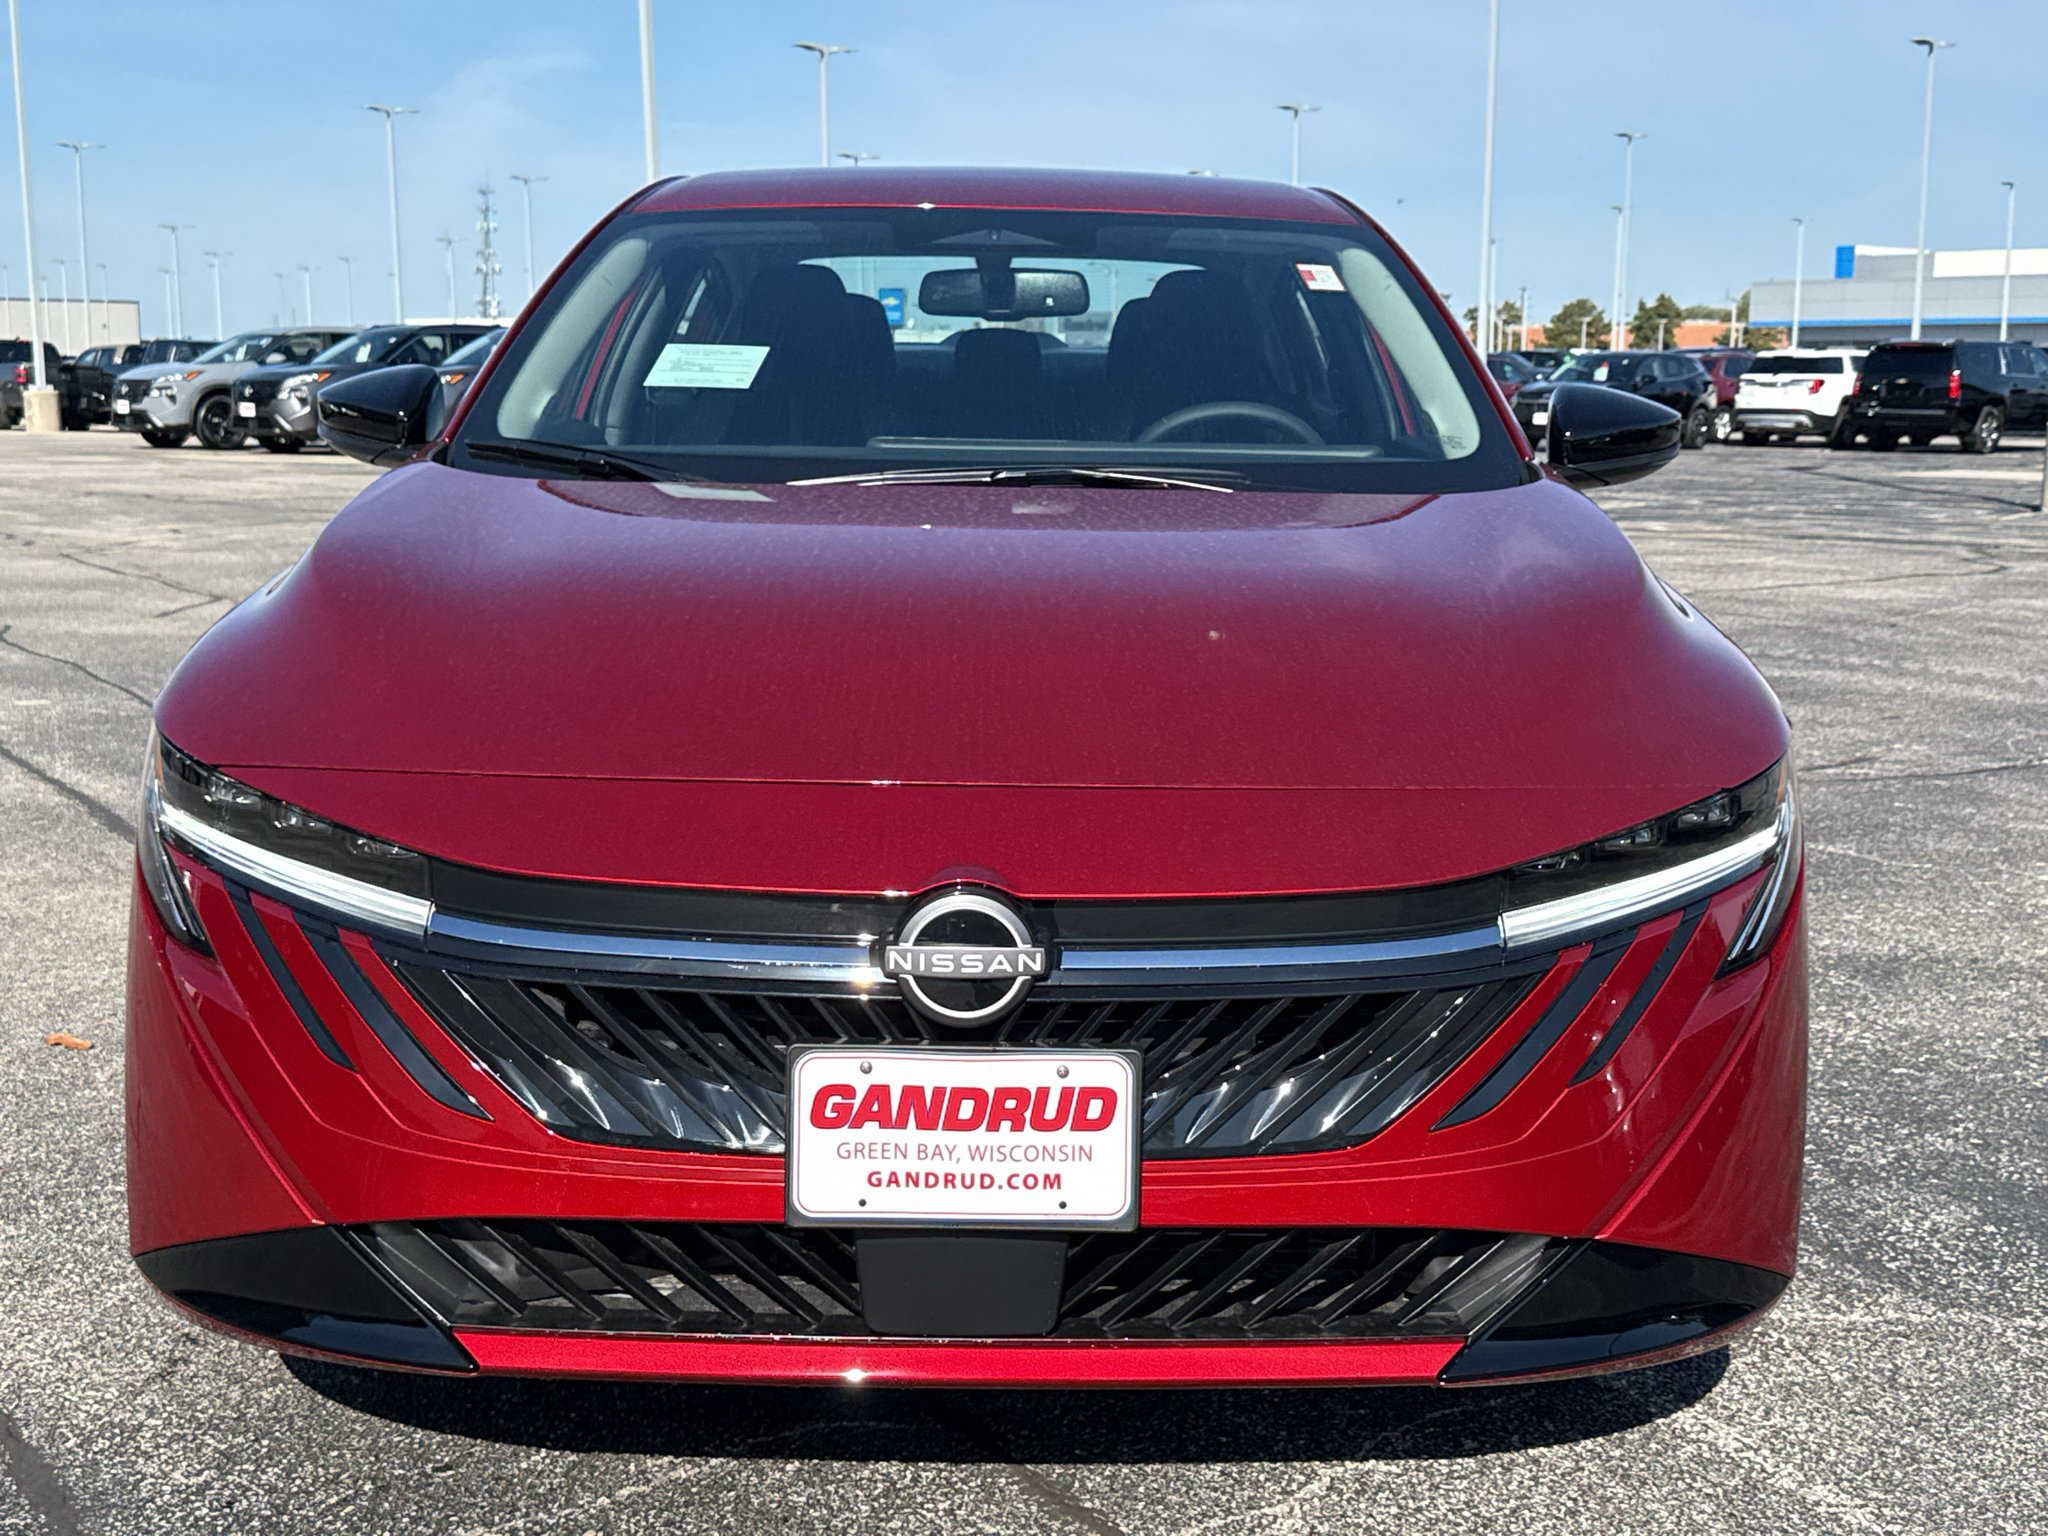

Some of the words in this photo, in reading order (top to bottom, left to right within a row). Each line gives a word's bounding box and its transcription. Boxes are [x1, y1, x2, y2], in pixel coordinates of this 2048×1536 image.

[887, 951, 1043, 973] NISSAN
[810, 1084, 1117, 1132] GANDRUD
[836, 1143, 907, 1160] GREEN
[917, 1145, 960, 1164] BAY,
[968, 1146, 1093, 1162] WISCONSIN
[867, 1171, 1062, 1190] GANDRUD.COM
